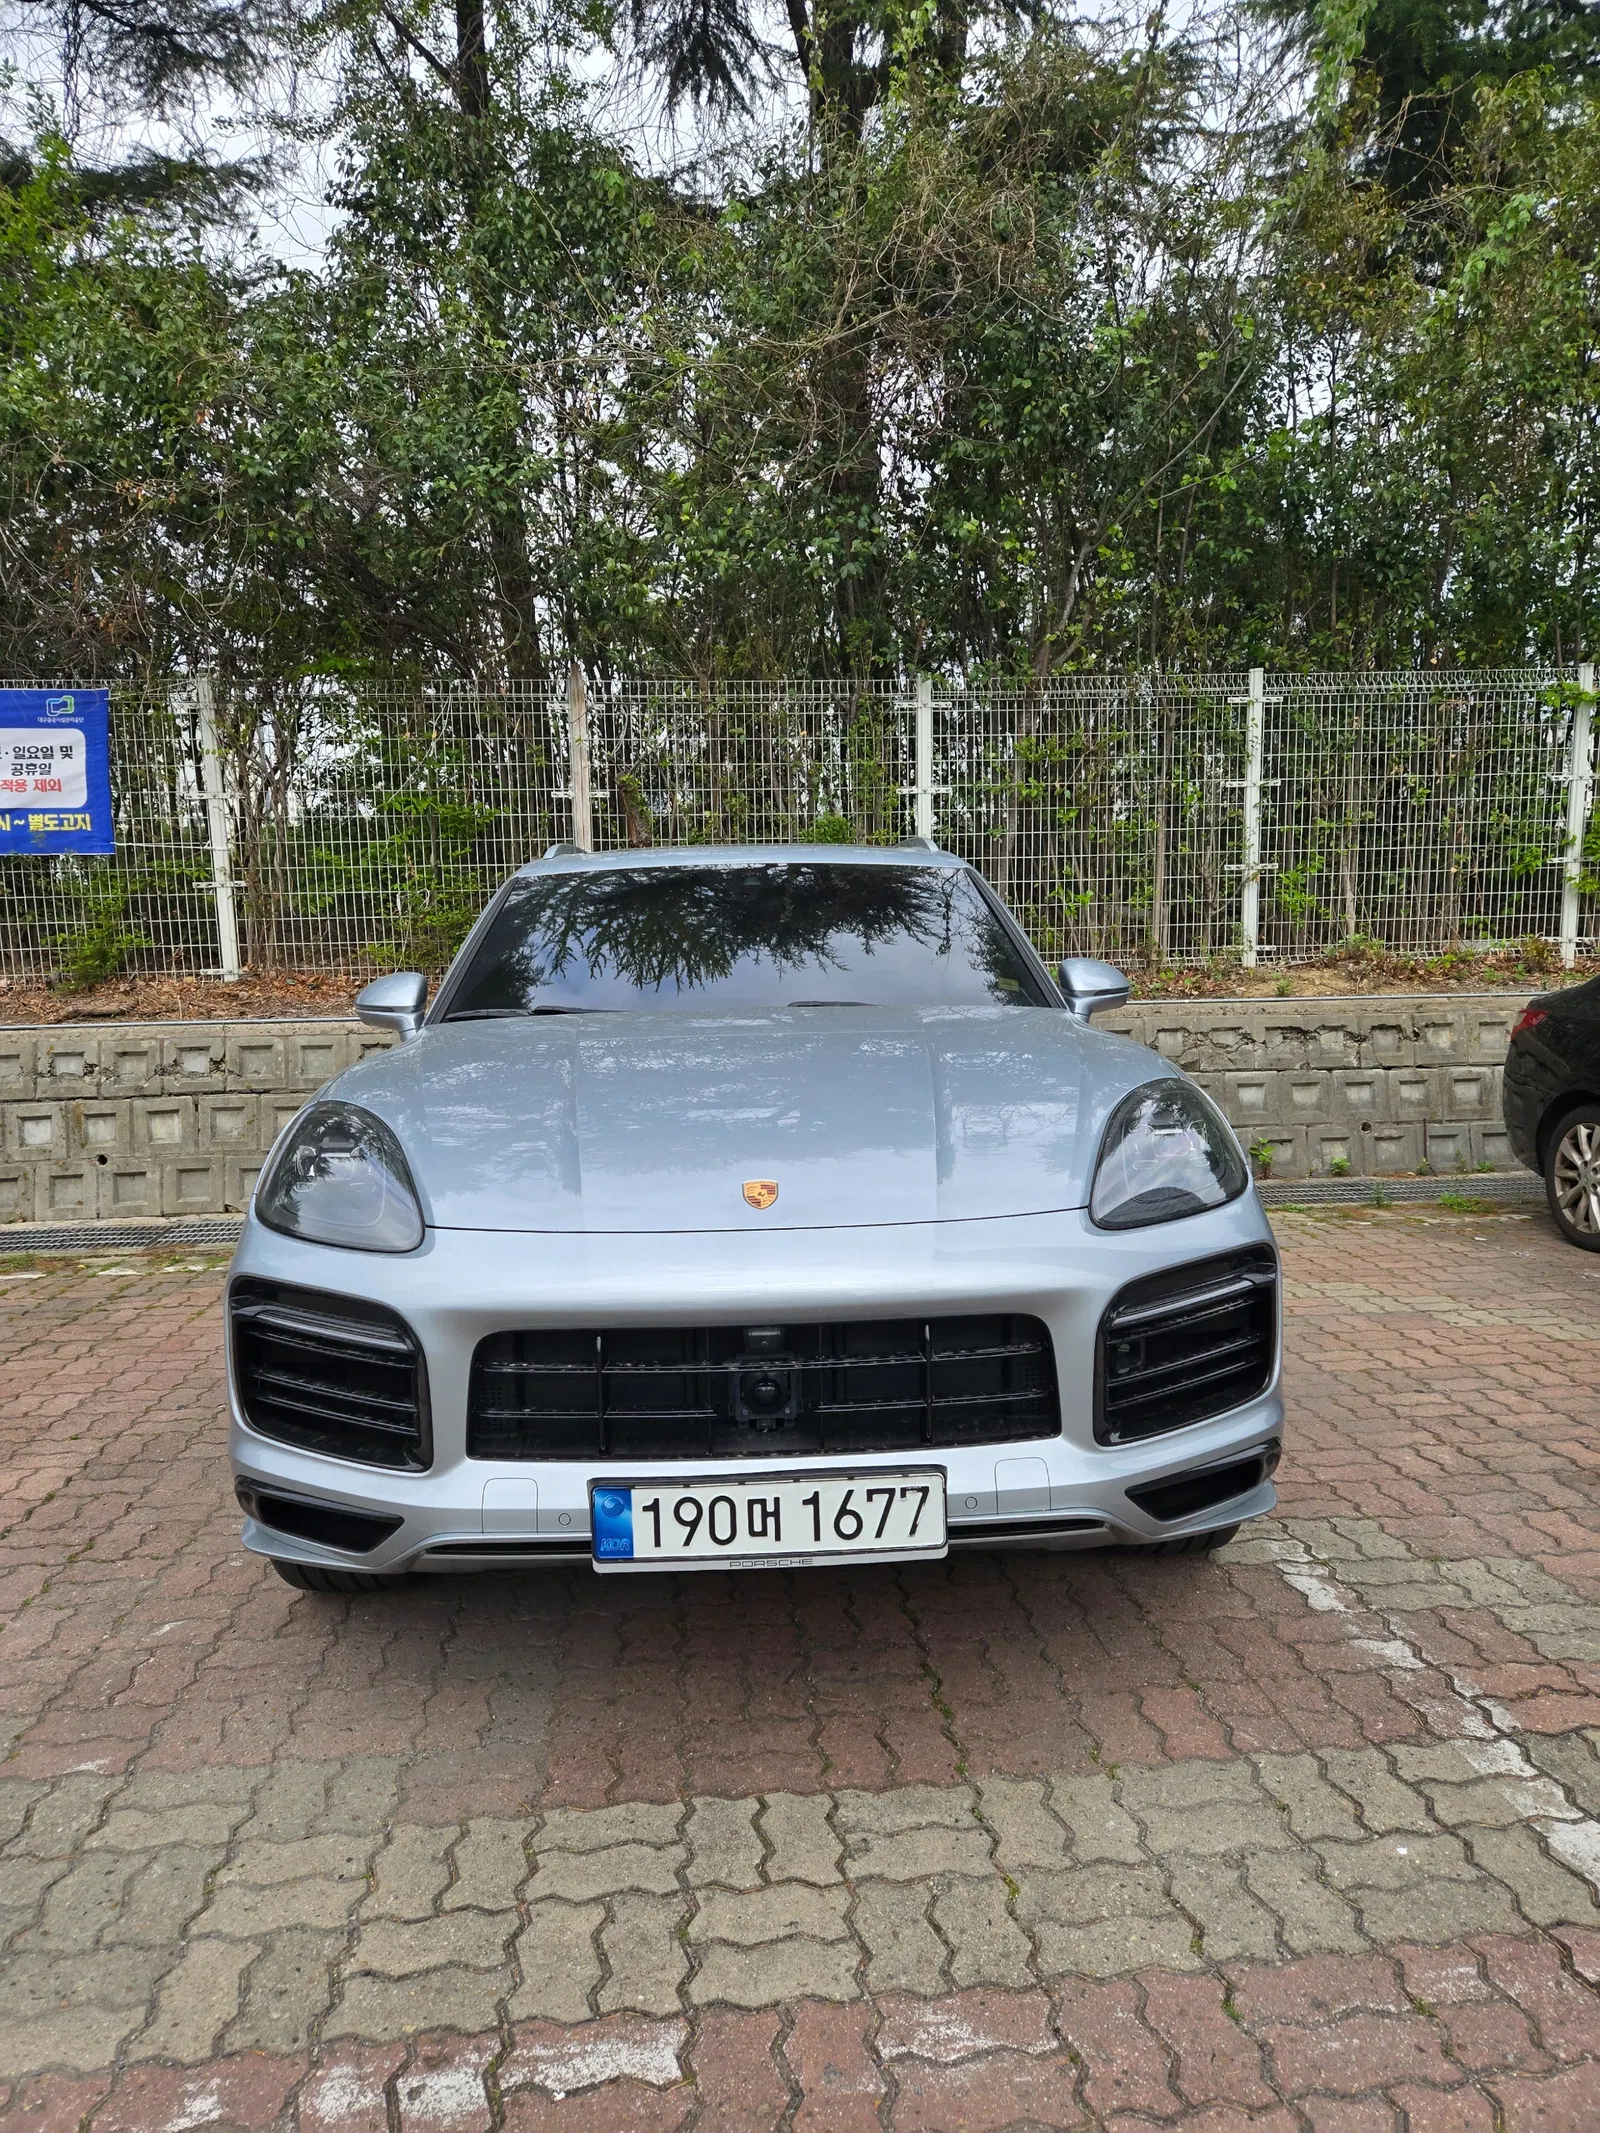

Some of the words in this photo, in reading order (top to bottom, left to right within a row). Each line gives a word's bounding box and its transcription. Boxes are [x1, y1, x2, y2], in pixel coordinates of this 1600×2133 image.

[60, 746, 73, 759] 및
[11, 763, 52, 776] 공휴일
[0, 779, 28, 793] 적용
[33, 779, 62, 792] 제외
[28, 813, 92, 831] 별도고지
[642, 1495, 782, 1548] 190머
[801, 1486, 930, 1542] 1677
[600, 1537, 630, 1552] KOR
[729, 1558, 814, 1568] PORSCHE
